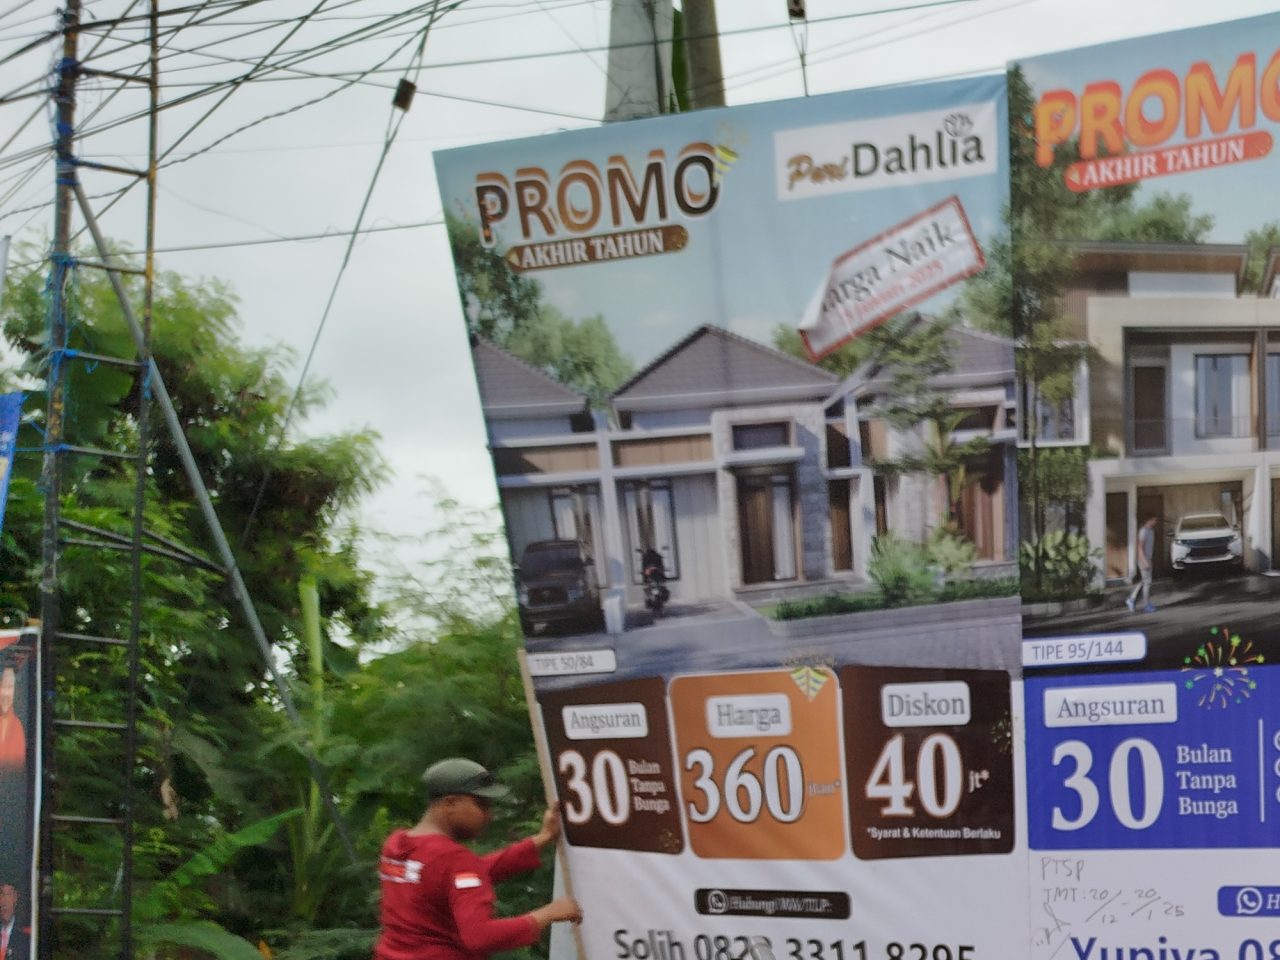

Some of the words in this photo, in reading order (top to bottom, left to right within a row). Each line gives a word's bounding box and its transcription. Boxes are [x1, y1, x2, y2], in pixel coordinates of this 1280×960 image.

[853, 130, 986, 178] Dahlia
[1083, 150, 1157, 186] AKHIR
[1162, 138, 1245, 173] TAHUN
[475, 141, 722, 246] PROMO
[521, 240, 588, 269] AKHIR
[591, 229, 664, 261] TAHUN
[821, 265, 881, 314] arga
[884, 221, 956, 272] Naik
[1031, 644, 1063, 660] TIPE
[1066, 640, 1124, 659] 95/144
[716, 702, 782, 731] Harga
[888, 692, 965, 718] Diskon
[1057, 698, 1166, 723] Angsuran
[571, 710, 641, 735] Angsuran
[1177, 745, 1232, 765] Bulan
[559, 750, 630, 825] 30
[685, 745, 805, 824] 360
[865, 732, 963, 819] 40
[1050, 737, 1165, 832] 30
[1177, 772, 1237, 791] Tanpa
[1178, 797, 1239, 818] Bunga
[912, 827, 961, 839] Ketentuan
